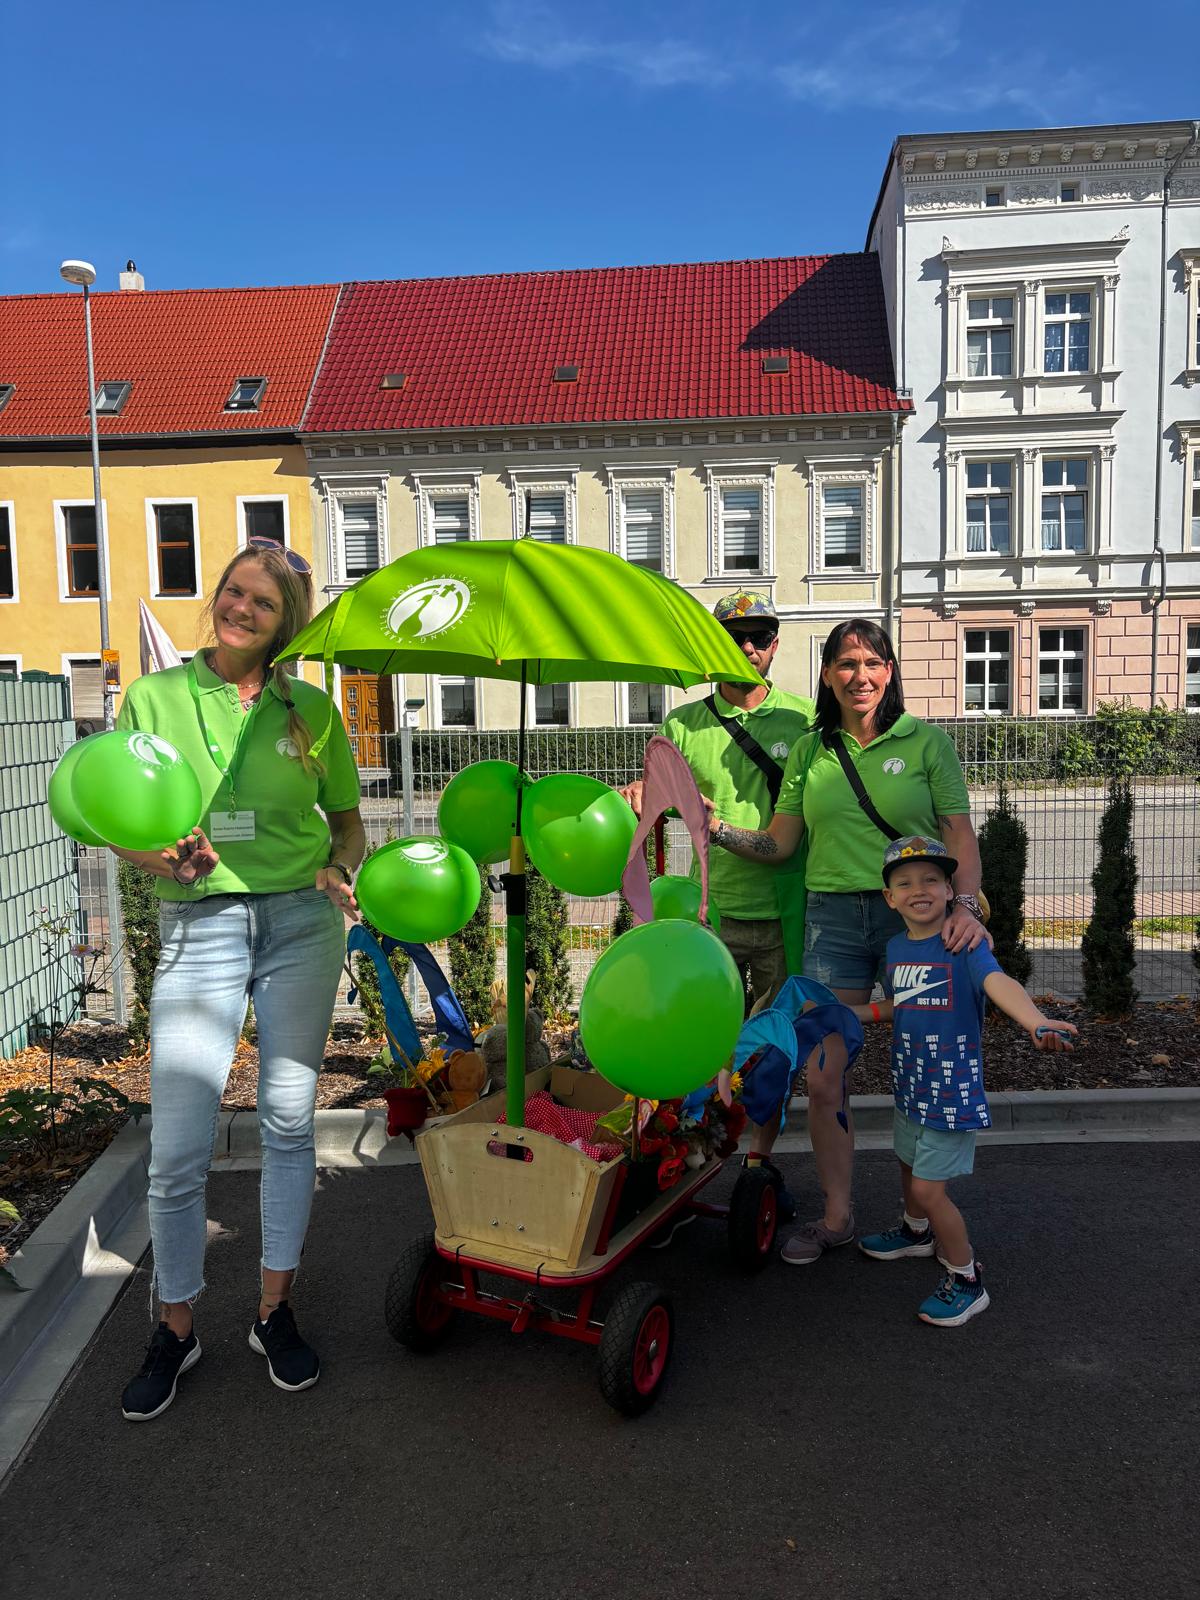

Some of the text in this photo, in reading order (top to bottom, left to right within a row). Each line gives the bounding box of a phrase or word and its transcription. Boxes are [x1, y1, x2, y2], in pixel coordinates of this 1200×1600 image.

[390, 583, 414, 601] VON
[420, 601, 477, 644] STIFTUNG
[894, 966, 932, 988] NIKE
[917, 998, 930, 1006] JUST
